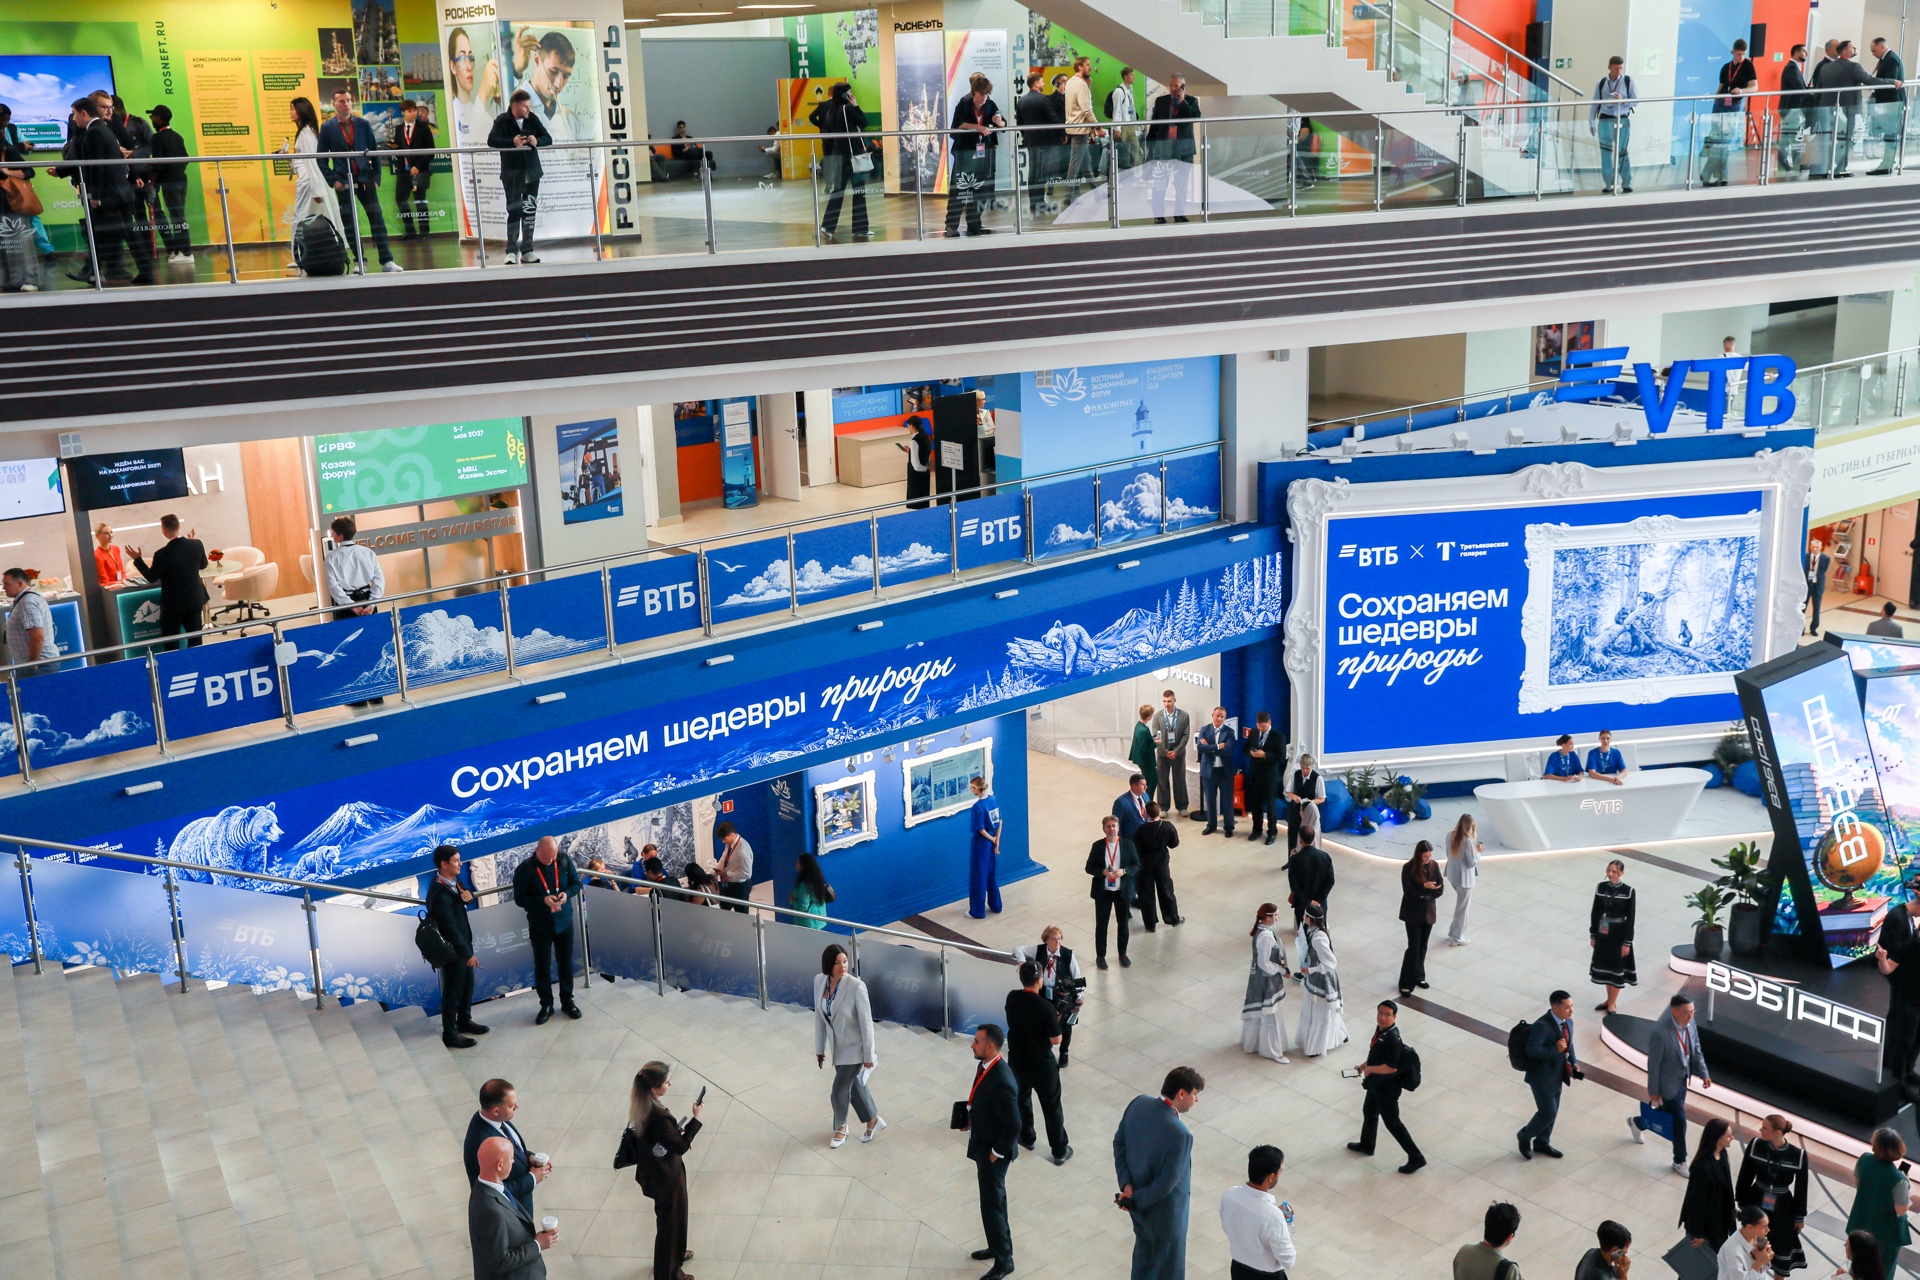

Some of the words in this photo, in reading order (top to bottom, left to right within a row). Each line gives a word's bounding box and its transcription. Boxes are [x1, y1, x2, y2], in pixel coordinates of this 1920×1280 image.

[445, 4, 495, 20] РОСНЕФТЬ
[894, 20, 943, 31] РОСНЕФТЬ
[155, 21, 173, 94] ROSNEFT.RU
[603, 25, 633, 230] РОСНЕФТЬ
[1147, 364, 1184, 375] ВЛАДИВОСТОК
[1157, 371, 1183, 380] СЕНТЯБРЯ
[1091, 372, 1124, 383] ВОСТОЧНЫЙ
[1091, 378, 1138, 390] ЭКОНОМИЧЕСКИЙ
[1147, 382, 1159, 390] 2026
[1091, 390, 1111, 398] ФОРУМ
[1633, 354, 1797, 434] VTB
[843, 405, 888, 416] ТЕХНОЛОГИИ
[1092, 400, 1134, 411] РОСКОНГРЕСС
[0, 464, 26, 474] ТКИ
[109, 465, 146, 474] KAZANFORUM
[321, 460, 356, 470] Казань
[463, 465, 478, 473] МВЦ
[1823, 456, 1871, 478] ГОСТИНАЯ
[322, 469, 356, 480] форум
[419, 527, 439, 541] TO
[441, 515, 516, 537] TATARSTAN
[981, 515, 1022, 546] ВТБ
[1460, 542, 1509, 550] Третьяковская
[1359, 546, 1398, 567] ВТБ
[644, 581, 696, 617] ВТБ
[1338, 588, 1509, 620] Сохраняем
[1338, 617, 1478, 646] шедевры
[1337, 648, 1483, 690] природы
[1170, 666, 1212, 689] РОССЕТИ
[204, 666, 274, 707] ВТБ
[450, 730, 649, 798] Сохраняем
[662, 690, 806, 749] шедевры
[820, 656, 956, 722] природы
[1594, 800, 1623, 815] VTB
[79, 855, 98, 863] ФОРУМ
[234, 924, 276, 947] ВТБ
